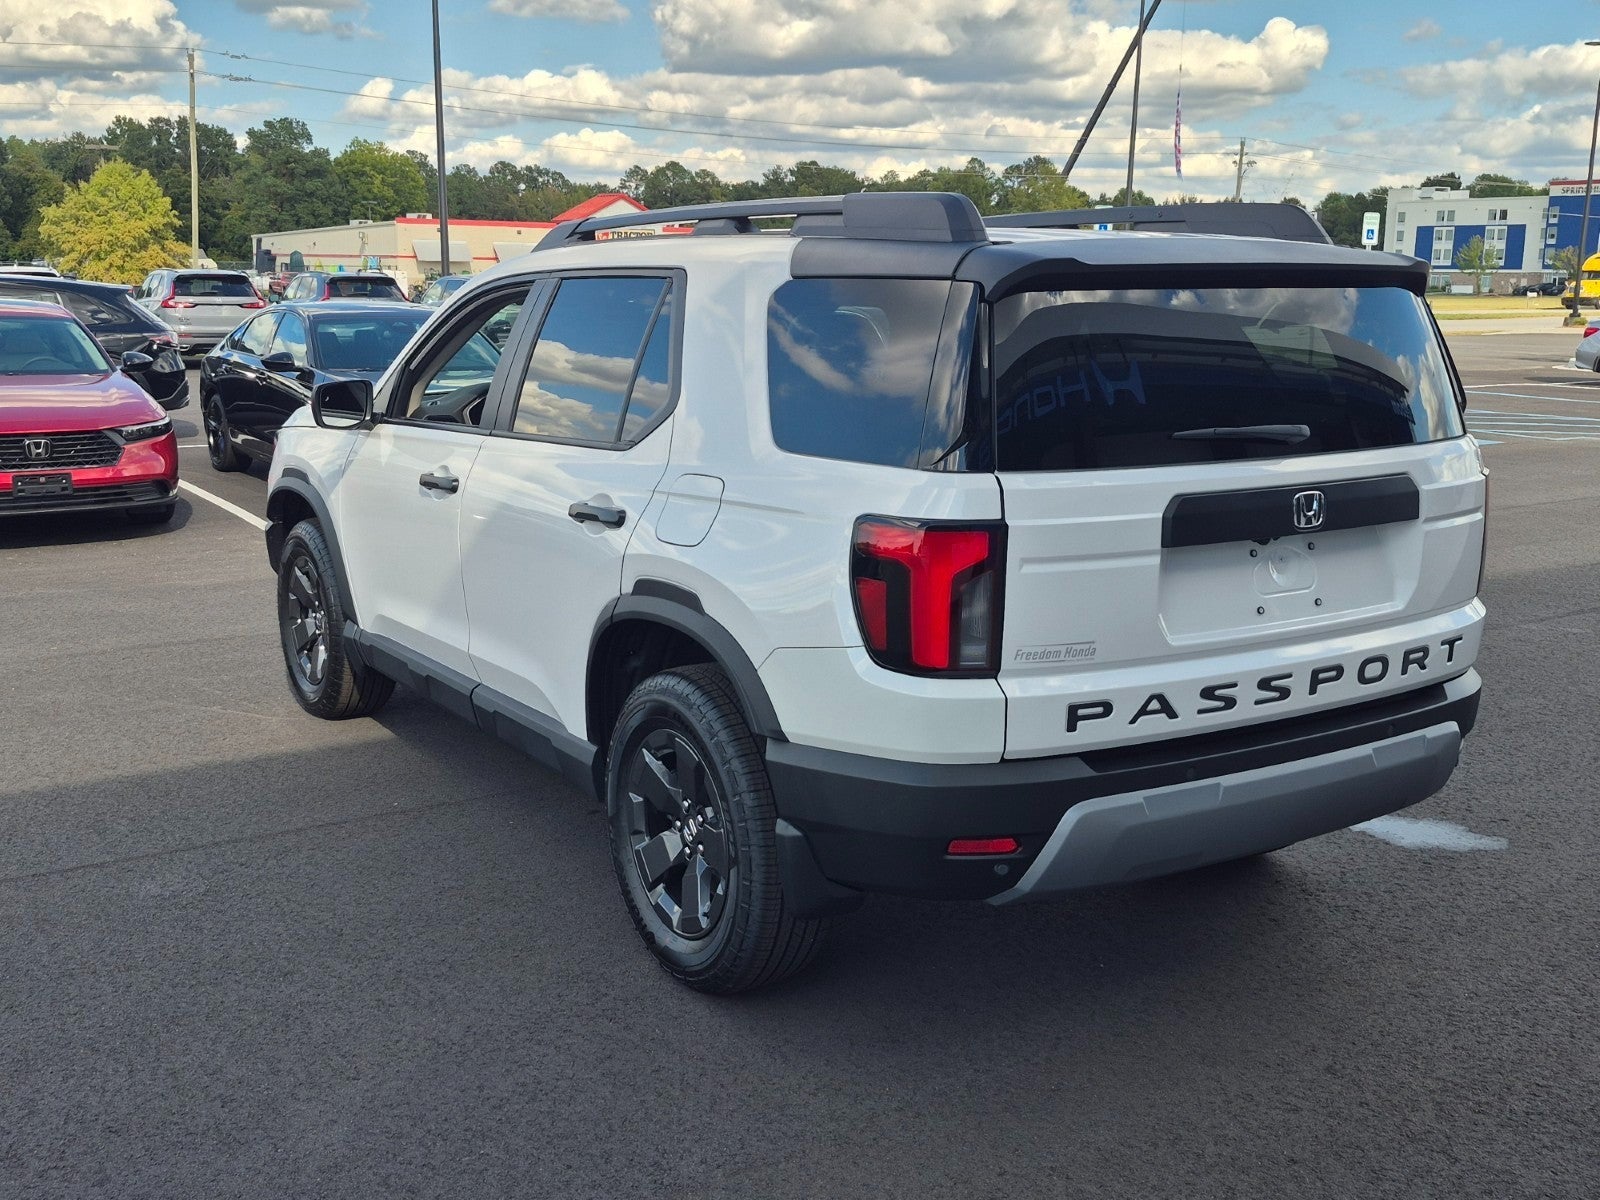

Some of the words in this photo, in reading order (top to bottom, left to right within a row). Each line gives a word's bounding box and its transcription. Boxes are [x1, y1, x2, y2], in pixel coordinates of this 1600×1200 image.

[1014, 648, 1062, 661] Freedom
[1064, 645, 1097, 659] Honda
[1066, 636, 1464, 733] PASSPORT
